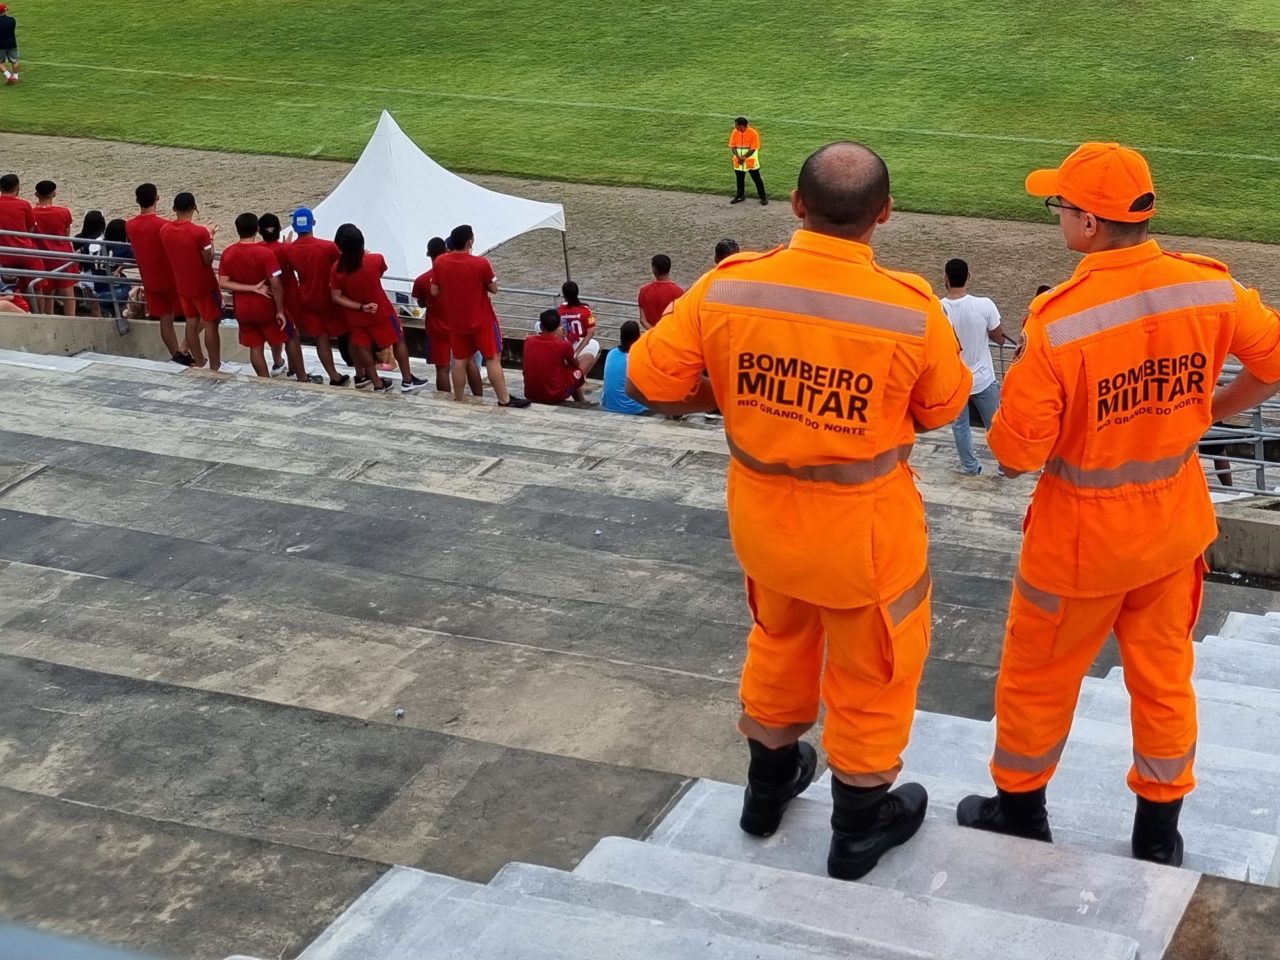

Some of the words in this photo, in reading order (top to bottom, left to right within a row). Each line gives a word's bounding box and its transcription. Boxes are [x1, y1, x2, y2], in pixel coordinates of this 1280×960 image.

[738, 352, 873, 394] BOMBEIRO
[1097, 352, 1207, 398] BOMBEIRO
[737, 372, 869, 423] MILITAR
[737, 399, 758, 407] RIO
[759, 403, 804, 423] GRANDE
[805, 417, 820, 430] DO
[824, 423, 866, 436] NORTE
[1097, 371, 1205, 422] MILITAR
[1114, 406, 1153, 425] GRANDE
[1156, 407, 1171, 416] DO
[1173, 397, 1204, 411] NORTE
